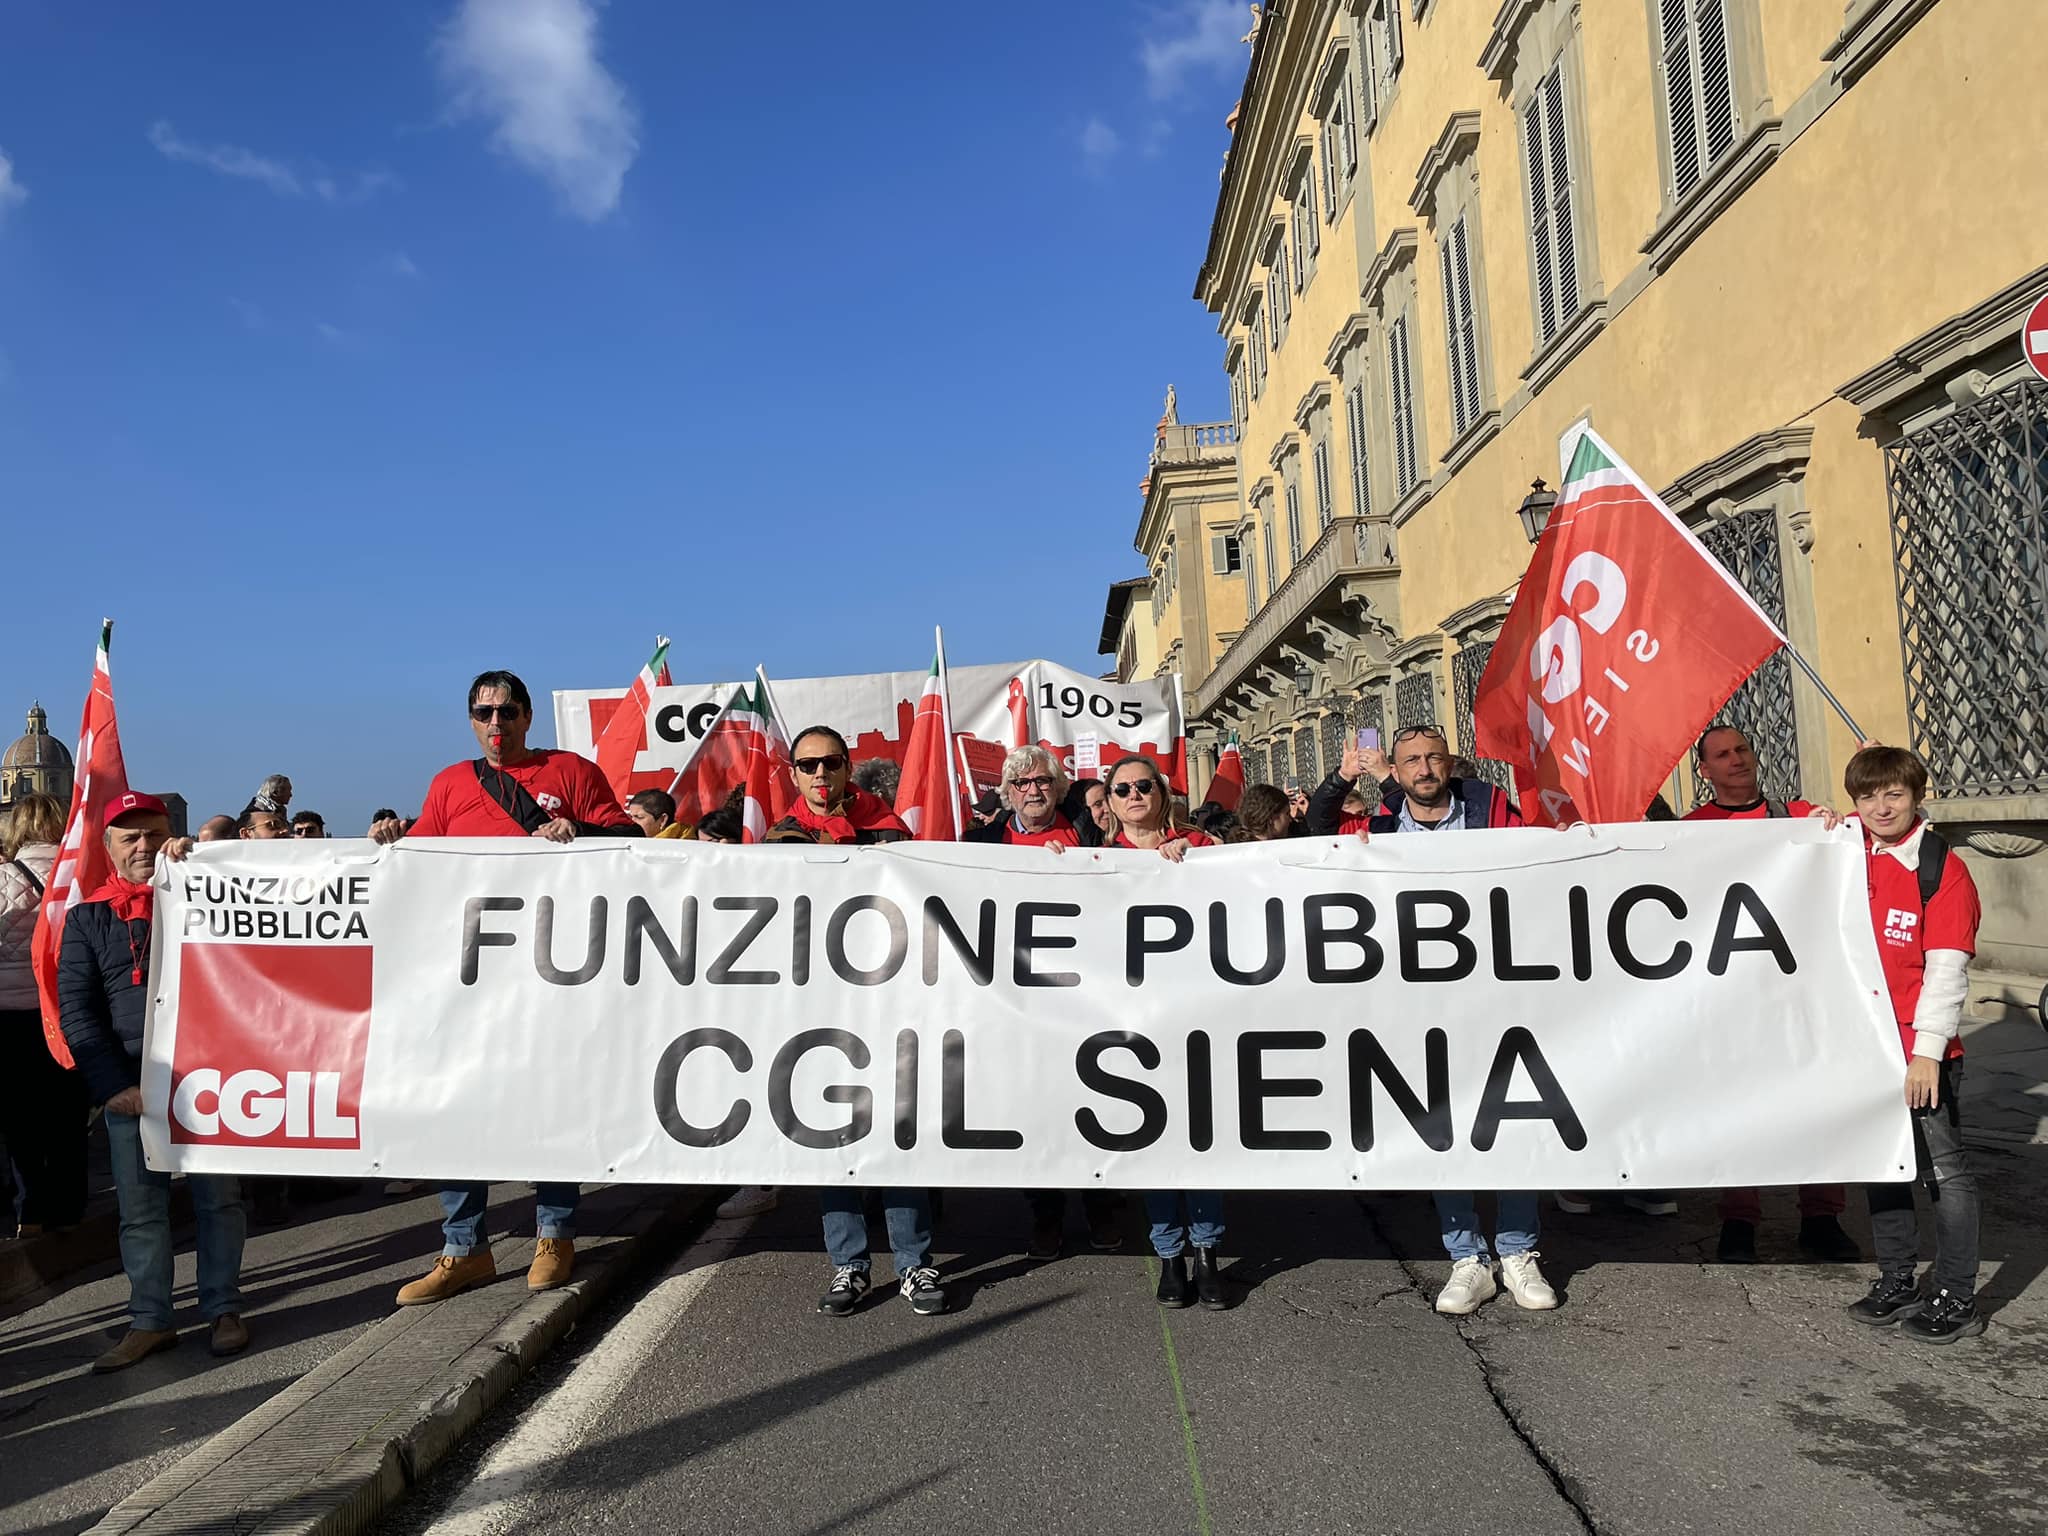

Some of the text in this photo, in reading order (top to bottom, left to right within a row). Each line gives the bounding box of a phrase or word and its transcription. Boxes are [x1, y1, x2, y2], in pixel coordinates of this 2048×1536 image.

[655, 703, 721, 743] CG
[1040, 682, 1142, 728] 1905
[184, 876, 370, 905] FUNZIONE
[184, 910, 369, 939] PUBBLICA
[460, 882, 1796, 986] FUNZIONE PUBBLICA
[1884, 928, 1913, 942] CGIL
[1886, 908, 1917, 929] FP
[173, 1068, 356, 1138] CGIL
[653, 1026, 1588, 1152] CGIL SIENA
